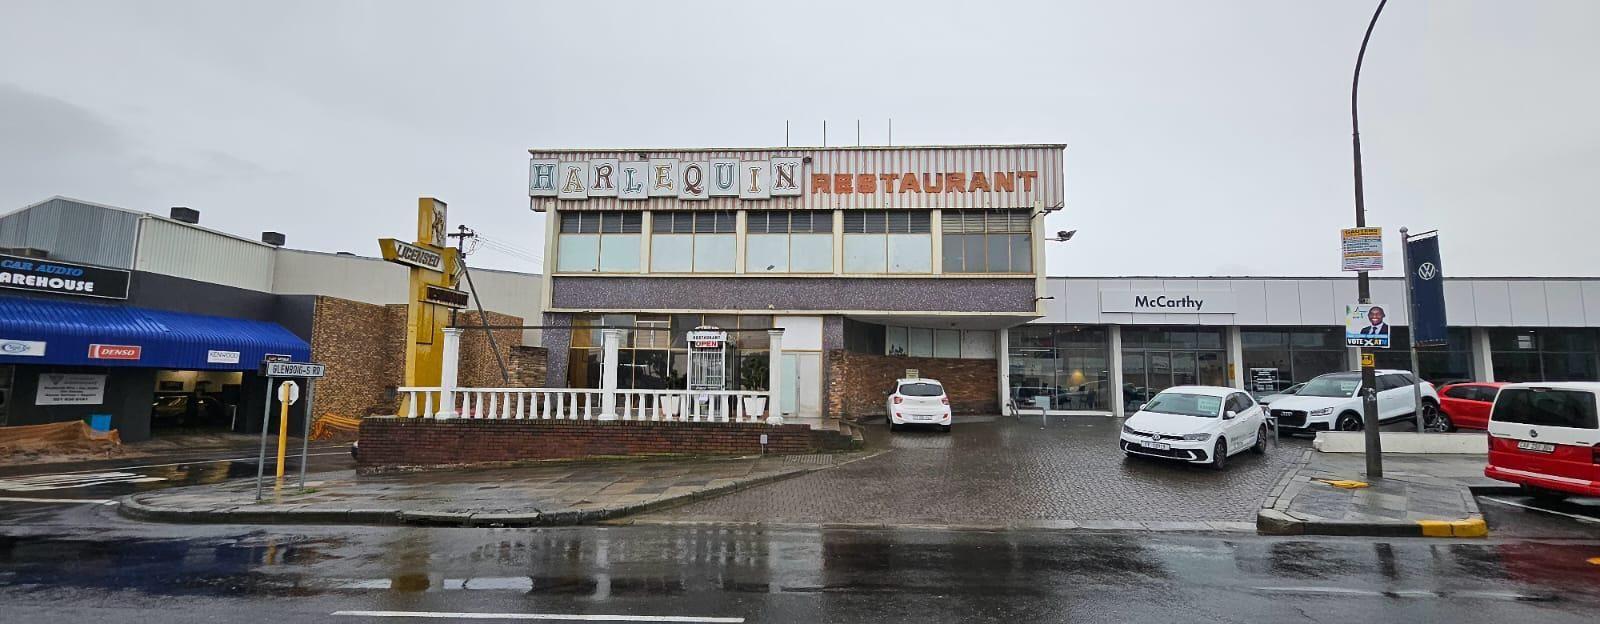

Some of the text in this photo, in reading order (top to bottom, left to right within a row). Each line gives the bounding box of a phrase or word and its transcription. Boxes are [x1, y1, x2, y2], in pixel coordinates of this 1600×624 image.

[533, 162, 1038, 195] HARLEQUIN RESTAURANT
[397, 244, 440, 268] LICENSED
[1, 260, 83, 276] CAR AUDIO
[1135, 295, 1203, 311] McCarthy
[101, 348, 135, 356] DENSO
